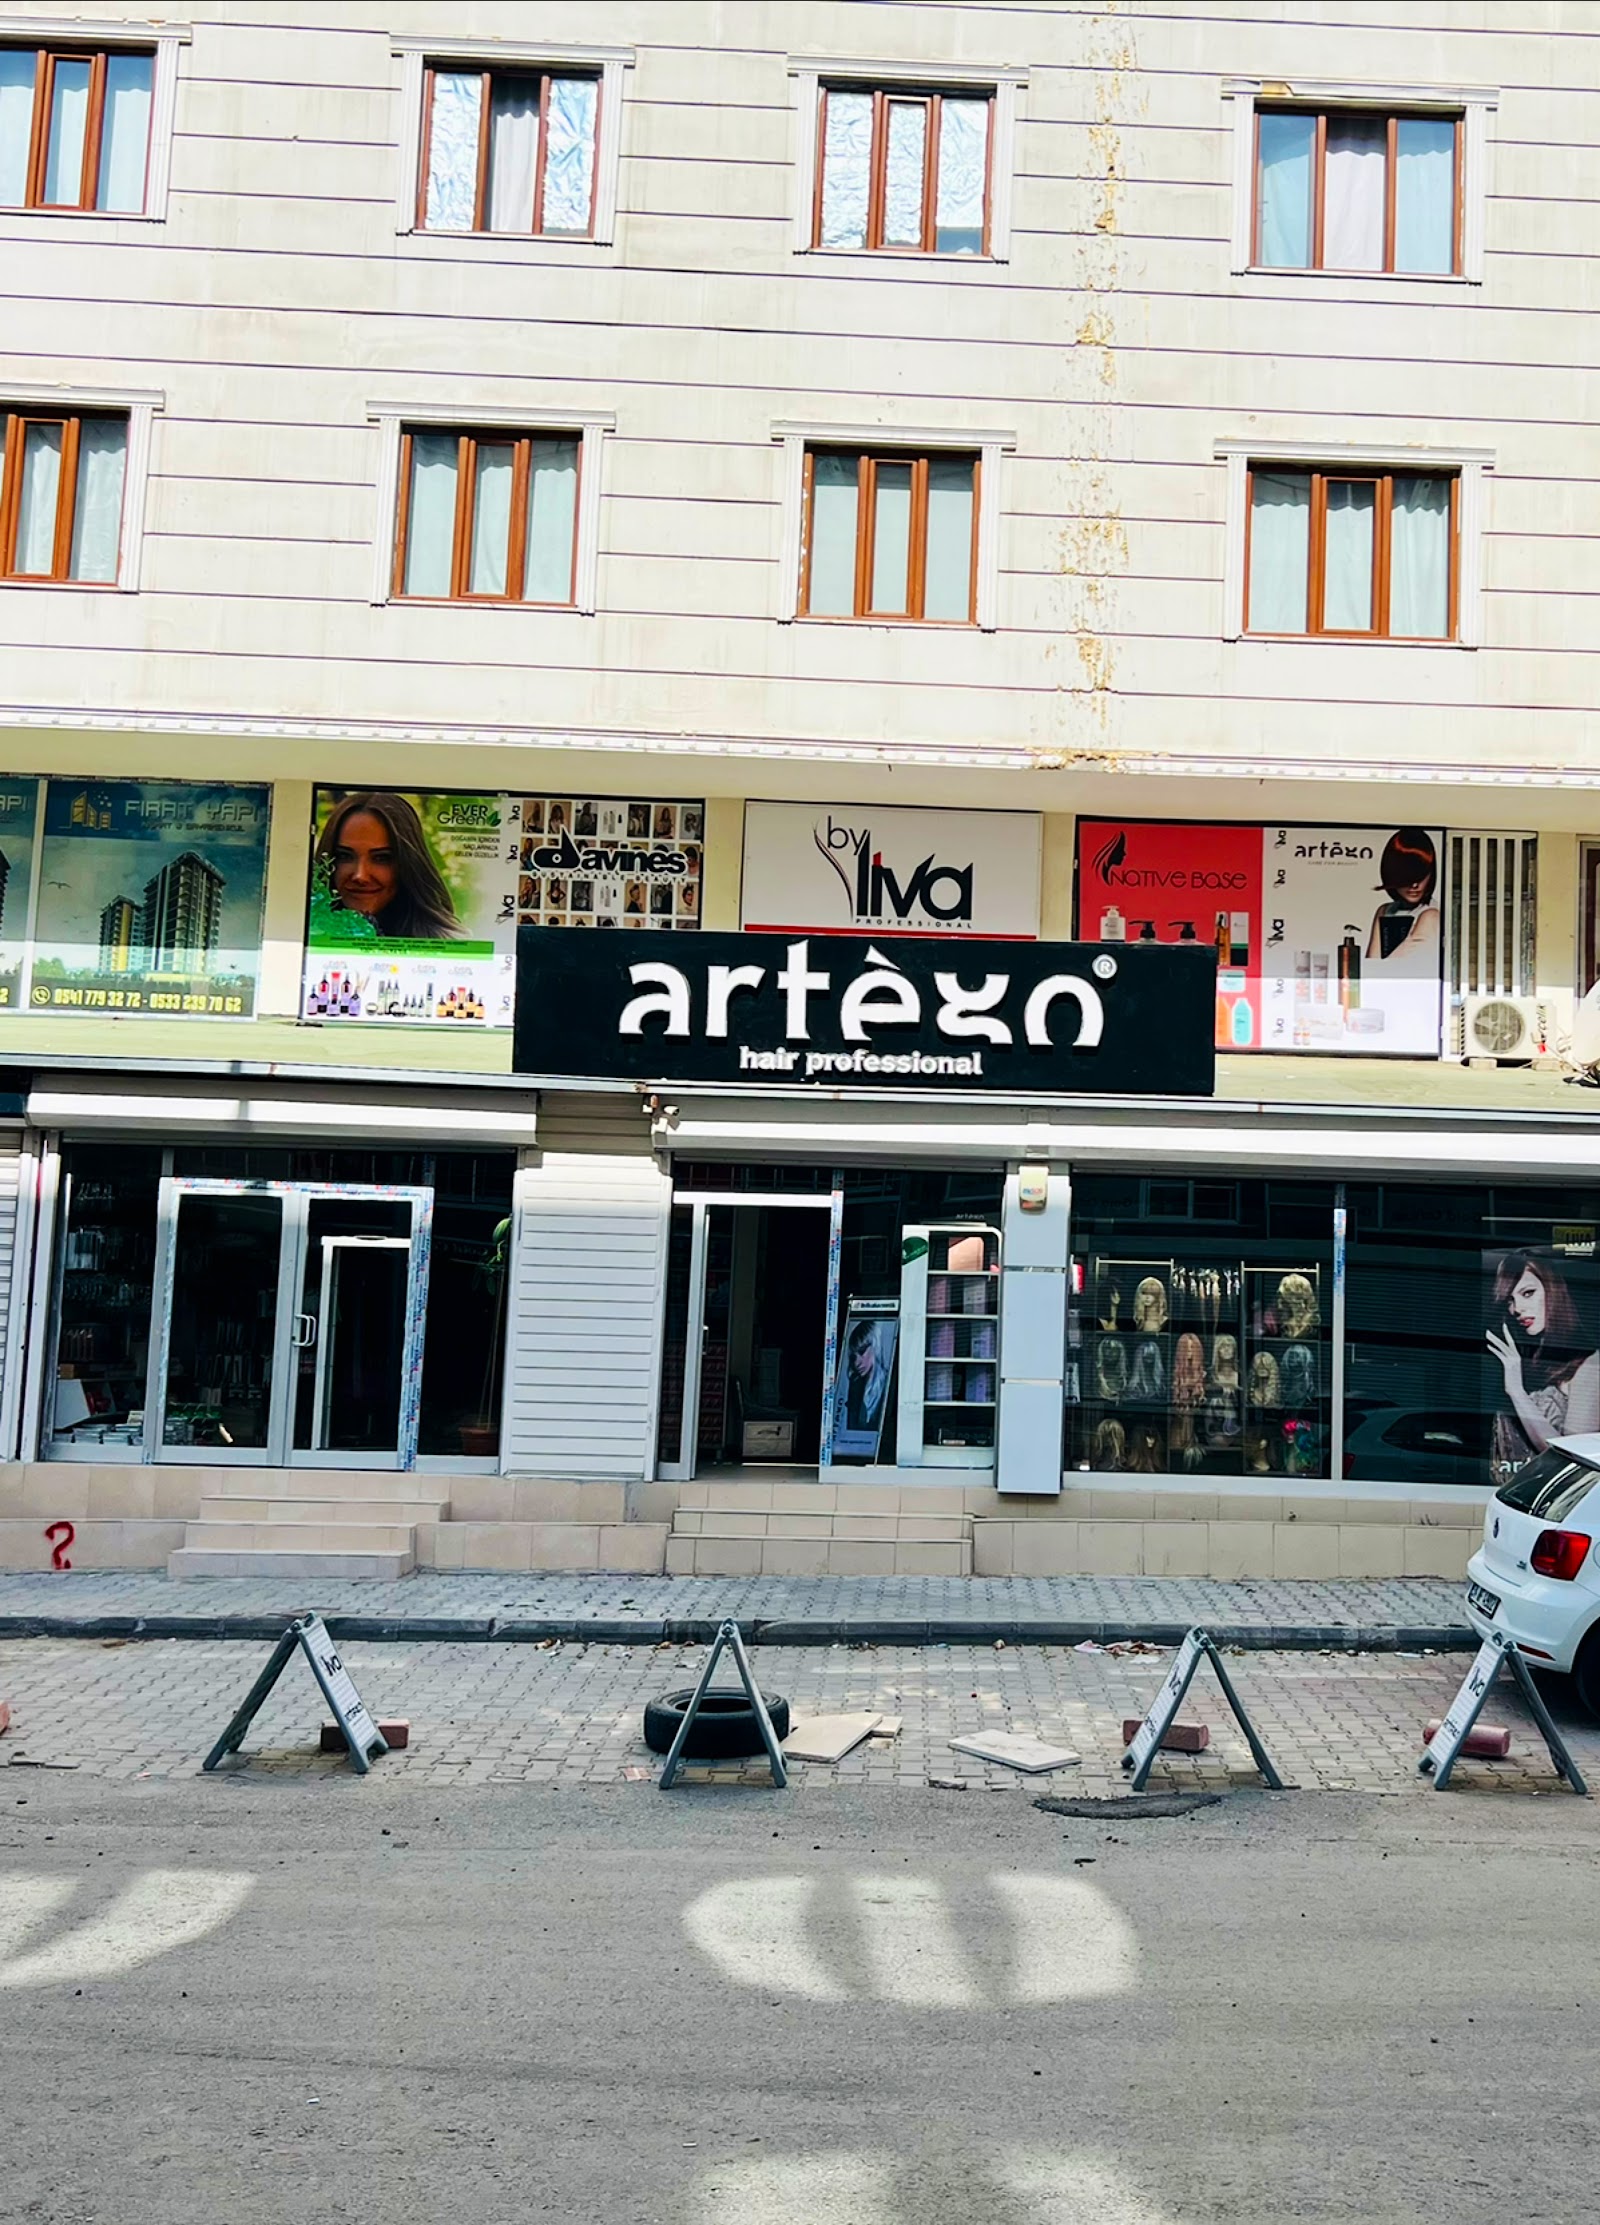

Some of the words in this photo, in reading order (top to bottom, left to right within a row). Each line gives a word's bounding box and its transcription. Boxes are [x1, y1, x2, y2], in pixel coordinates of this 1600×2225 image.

[124, 800, 194, 819] FIRAT
[206, 798, 258, 822] YAPI
[437, 811, 487, 826] Green
[451, 803, 489, 817] EVER
[827, 815, 868, 855] by
[533, 826, 687, 874] davines
[531, 871, 626, 881] SUSTAINABLE
[856, 831, 973, 920] liva
[856, 918, 972, 929] PROFESSIONAL
[53, 988, 83, 1005] 0541
[85, 989, 105, 1006] 779
[107, 990, 124, 1007] 32
[126, 991, 142, 1008] 72
[149, 993, 181, 1010] 0533
[182, 994, 207, 1011] 239
[225, 996, 242, 1013] 62
[739, 1045, 800, 1071] hair
[805, 1049, 984, 1077] professional
